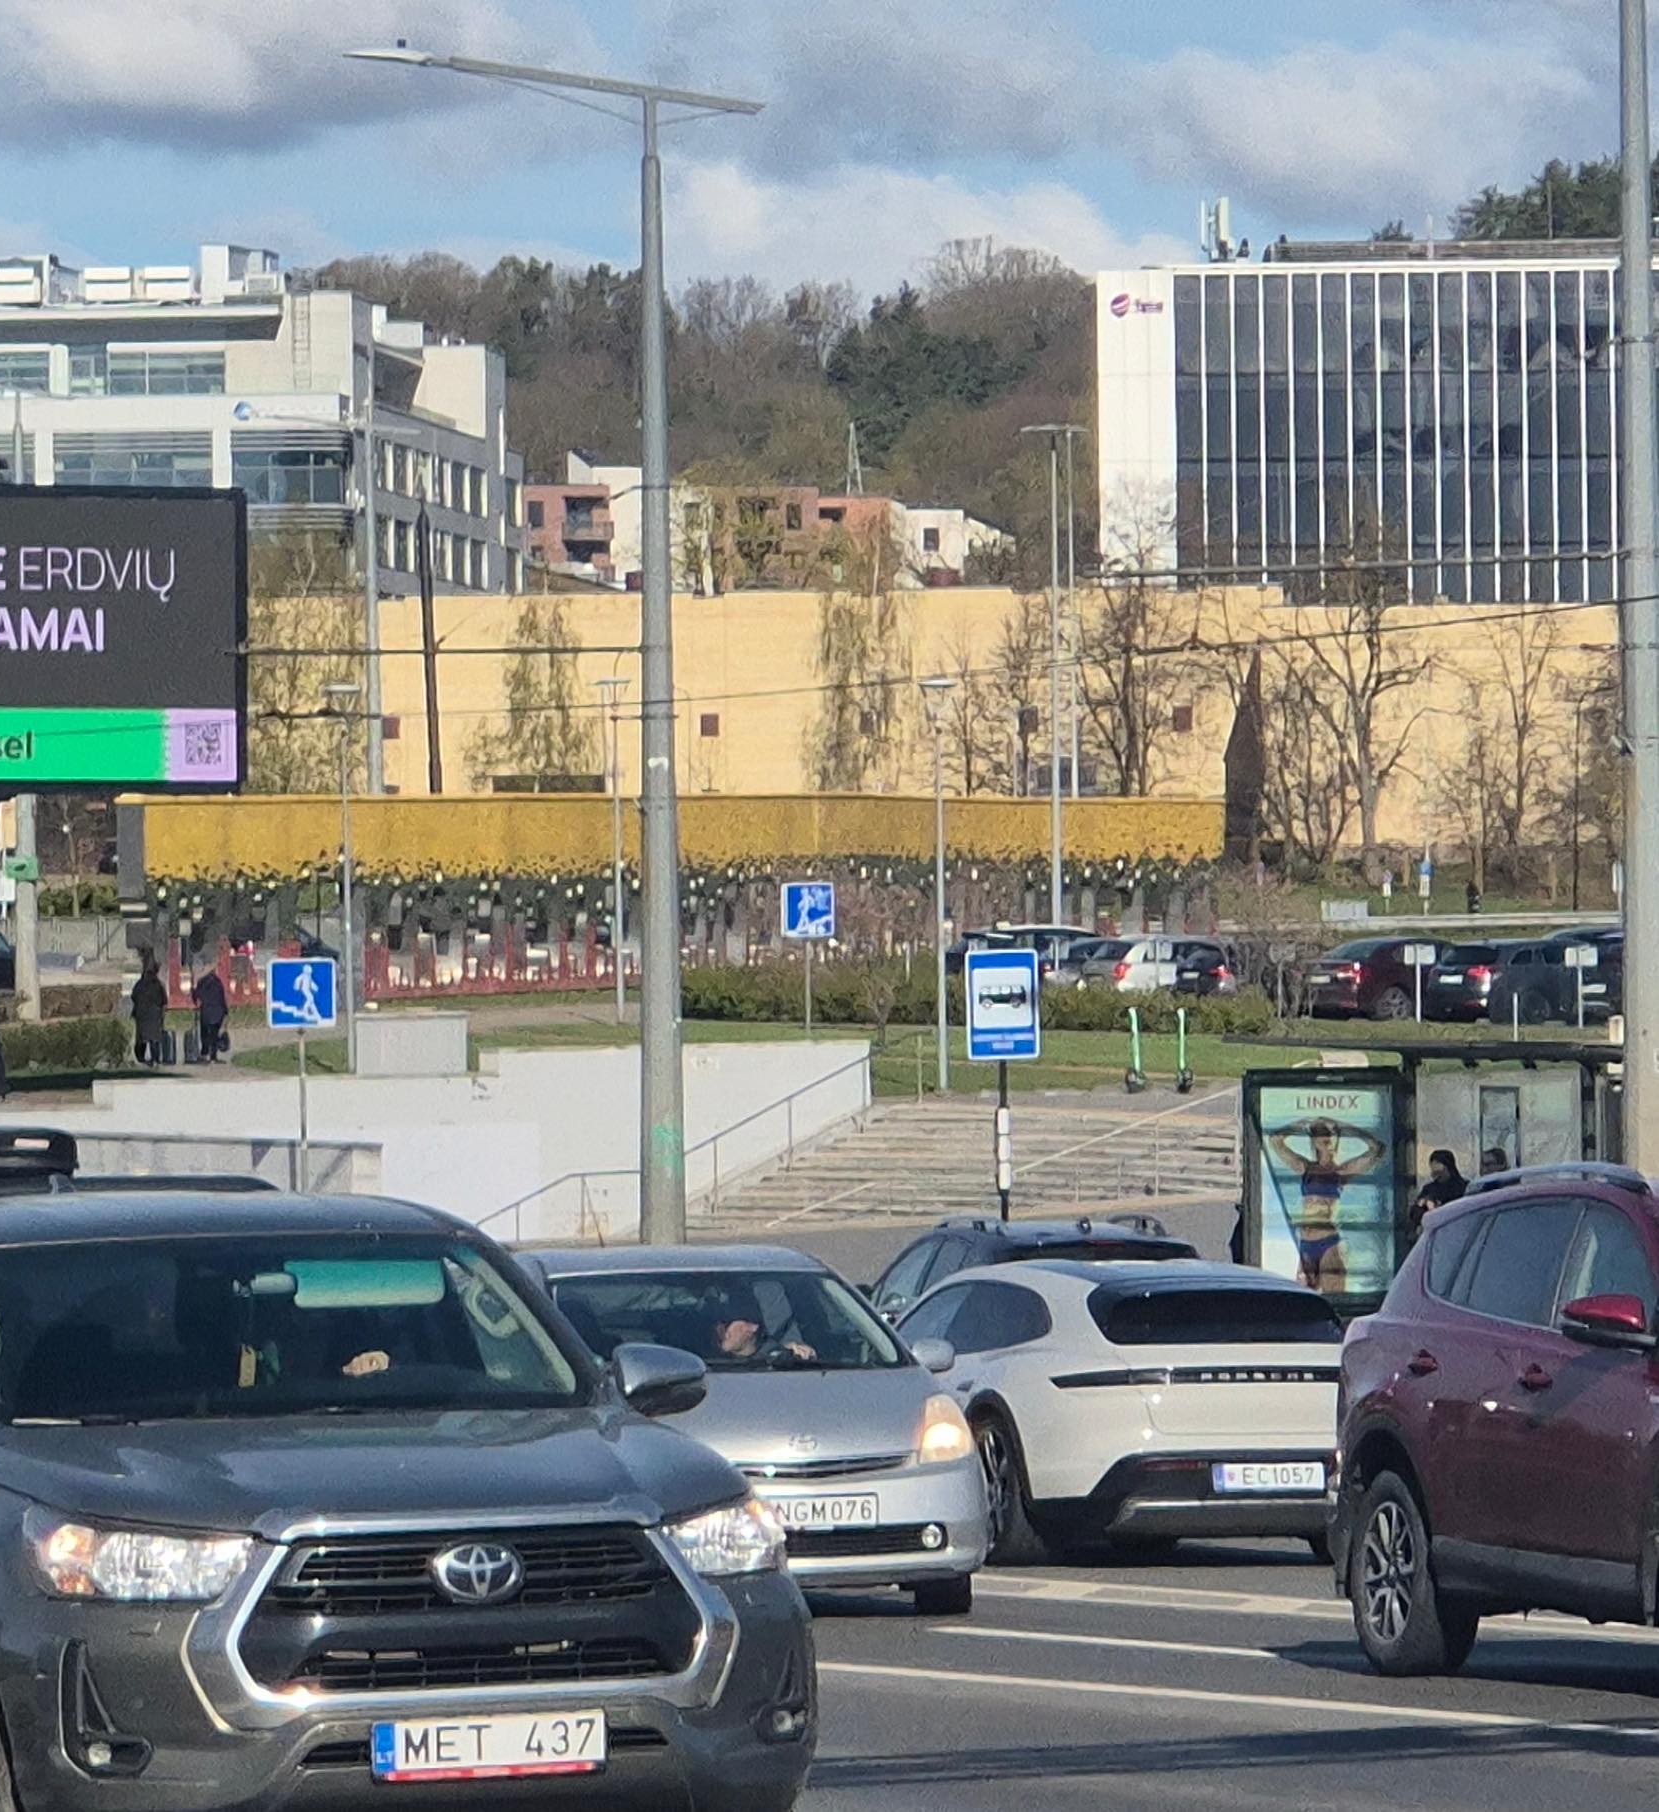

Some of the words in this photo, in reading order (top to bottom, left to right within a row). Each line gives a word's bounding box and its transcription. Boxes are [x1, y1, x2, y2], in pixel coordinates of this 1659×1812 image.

[18, 547, 176, 602] ERDVIŲ
[1296, 1095, 1359, 1110] LINDEX
[1242, 1466, 1315, 1485] EC1057
[776, 1499, 873, 1522] NGM076
[404, 1724, 492, 1764] MET
[524, 1718, 597, 1758] 437
